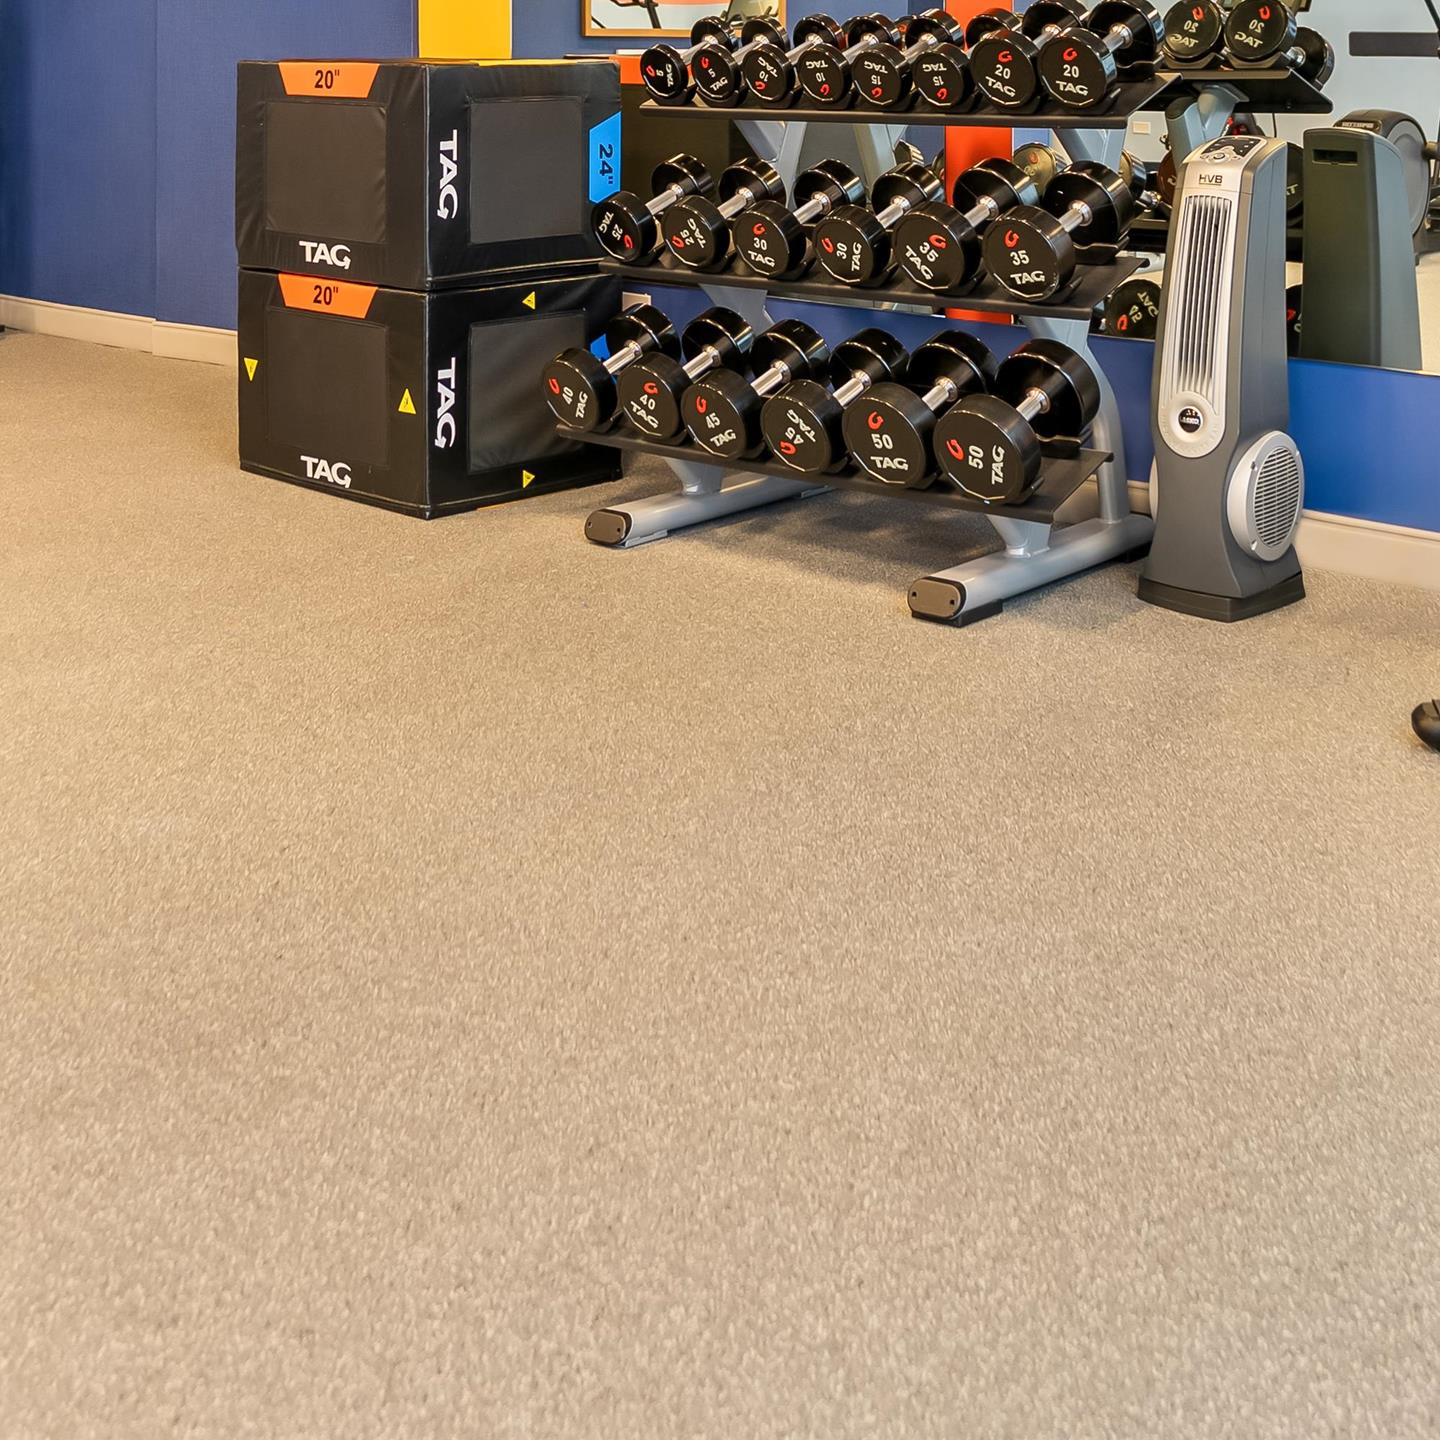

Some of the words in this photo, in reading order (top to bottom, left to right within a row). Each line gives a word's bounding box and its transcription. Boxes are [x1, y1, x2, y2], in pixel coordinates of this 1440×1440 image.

[708, 68, 716, 78] 5
[757, 57, 778, 78] TAG
[805, 60, 828, 70] TAG
[863, 61, 888, 74] TAG
[922, 62, 947, 73] TAG
[994, 64, 1011, 79] 20
[1063, 64, 1079, 78] 20
[314, 68, 340, 89] 20"
[666, 63, 674, 88] TAG
[710, 78, 729, 92] TAG
[815, 72, 826, 83] 10
[870, 74, 882, 86] 15
[932, 75, 944, 87] 15
[985, 76, 1016, 98] TAG
[1055, 80, 1089, 96] TAG
[599, 143, 614, 185] 24"
[436, 129, 458, 220] TAG
[1199, 173, 1223, 184] HVB
[598, 211, 615, 234] TAG
[612, 223, 623, 242] 25
[681, 228, 695, 246] 25
[687, 217, 706, 249] TAG
[753, 237, 768, 251] 30
[836, 242, 848, 260] 30
[919, 241, 939, 263] 35
[299, 240, 352, 270] TAG
[747, 250, 776, 267] TAG
[851, 241, 863, 272] TAG
[904, 245, 934, 280] TAG
[1010, 249, 1030, 266] 35
[1010, 270, 1046, 286] TAG
[313, 284, 340, 306] 20"
[434, 357, 456, 449] TAG
[562, 386, 574, 405] 40
[575, 390, 589, 419] TAG
[639, 393, 656, 410] 40
[630, 400, 659, 429] TAG
[705, 413, 721, 430] 45
[784, 426, 805, 445] 45
[786, 409, 817, 443] TAG
[709, 429, 737, 448] TAG
[871, 433, 894, 450] 50
[870, 456, 909, 471] TAG
[968, 445, 984, 470] 50
[991, 444, 1006, 486] TAG
[300, 455, 352, 489] TAG
